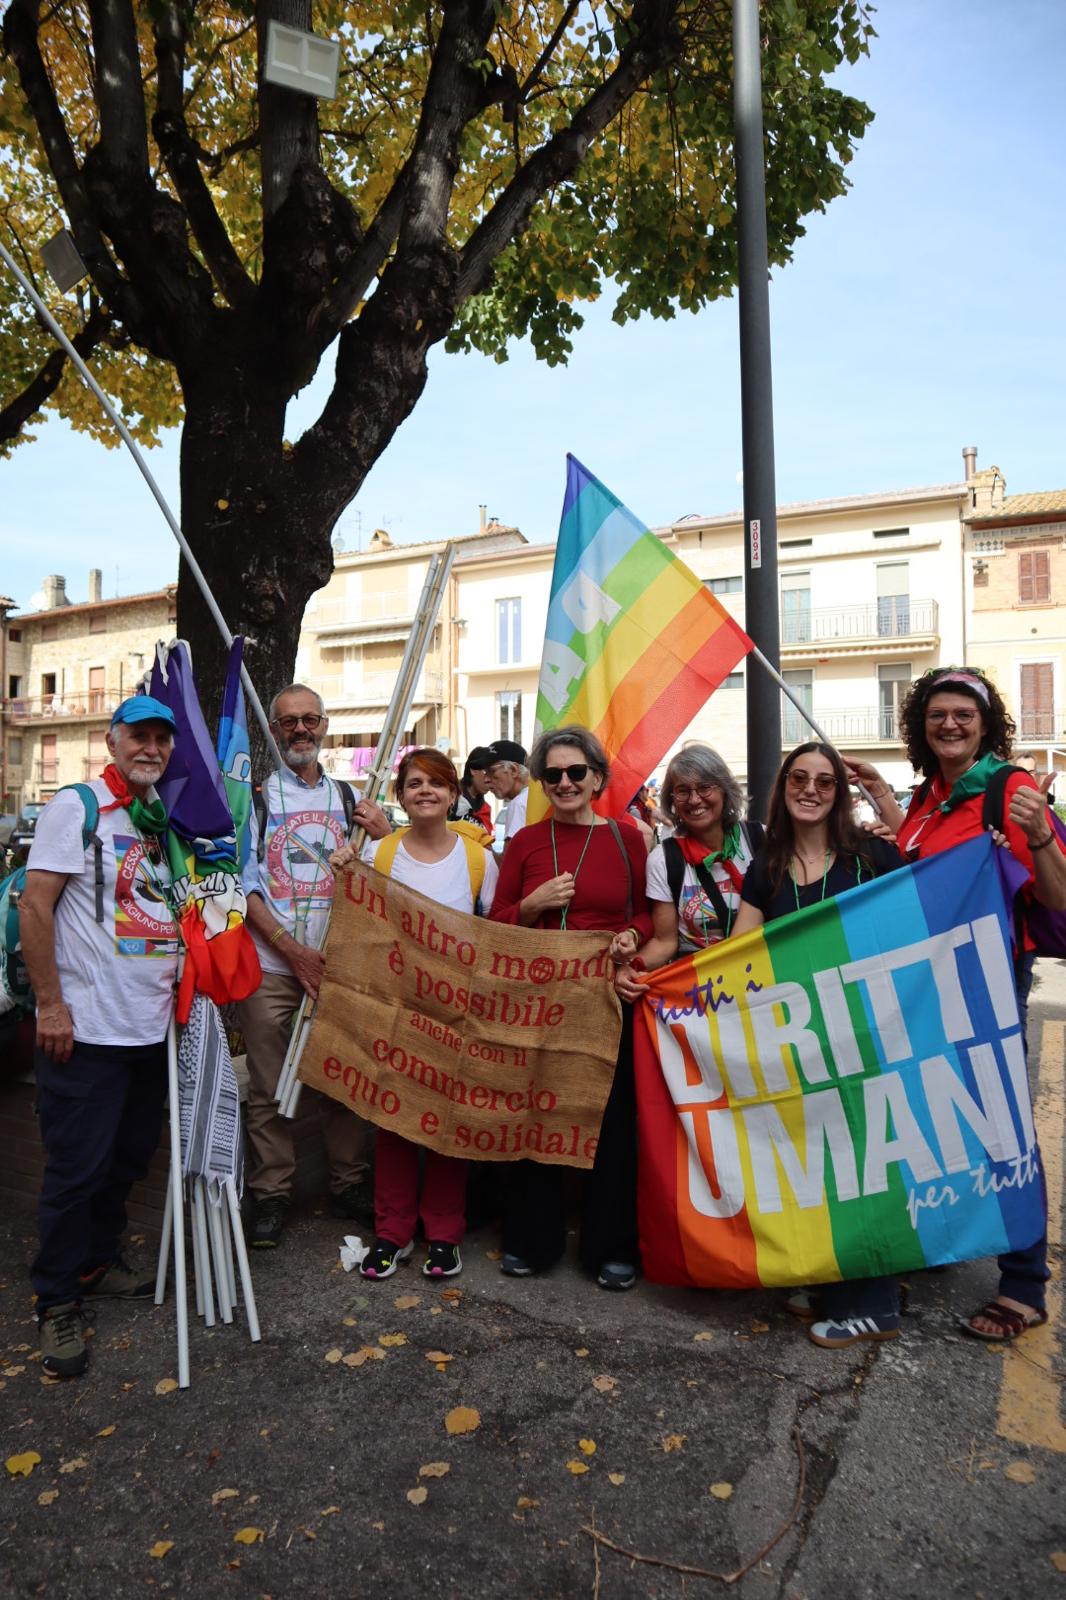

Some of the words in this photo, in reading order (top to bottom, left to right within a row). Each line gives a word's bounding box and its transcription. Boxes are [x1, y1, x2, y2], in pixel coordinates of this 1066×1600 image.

[533, 570, 622, 738] PA
[270, 812, 310, 852] CESSATE
[312, 813, 321, 823] IL
[122, 898, 159, 931] DIGIUNO
[343, 870, 388, 921] Un
[401, 911, 476, 966] altro
[489, 948, 615, 985] mond
[389, 940, 404, 976] è
[415, 965, 565, 1028] possibile
[649, 975, 734, 1025] tutti
[746, 963, 763, 993] i
[657, 913, 1021, 1105] DIRITTI
[373, 1037, 557, 1113] commercio
[410, 1011, 463, 1051] anche
[468, 1043, 505, 1067] con
[513, 1047, 528, 1067] il
[323, 1055, 401, 1115] equo
[420, 1110, 440, 1136] e
[454, 1121, 599, 1160] solidale
[678, 1033, 1036, 1219] UMANI
[905, 1180, 960, 1230] per
